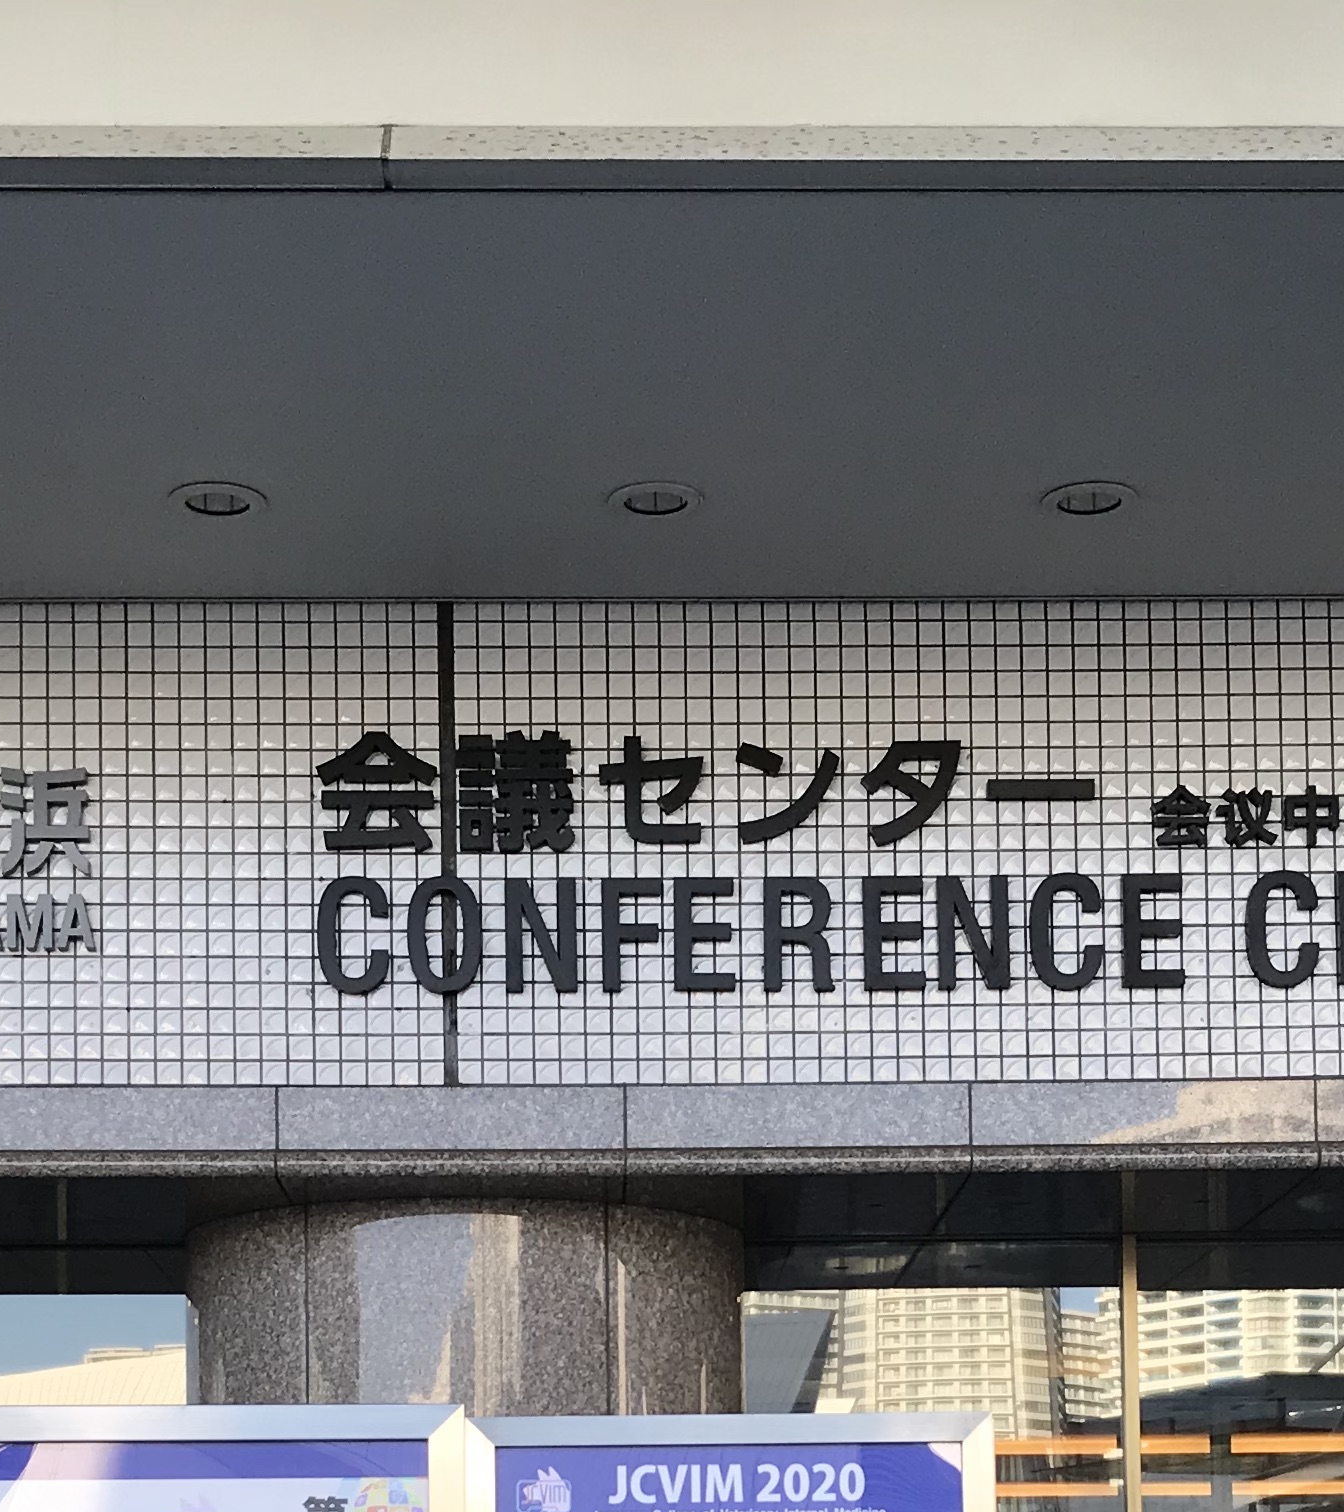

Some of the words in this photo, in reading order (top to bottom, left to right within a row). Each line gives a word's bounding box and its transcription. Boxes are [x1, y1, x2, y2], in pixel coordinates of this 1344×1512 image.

[316, 731, 1096, 852] 会議センター
[317, 872, 1186, 995] CONFERENCE
[608, 1463, 744, 1504] JCVIM
[756, 1462, 866, 1502] 2020
